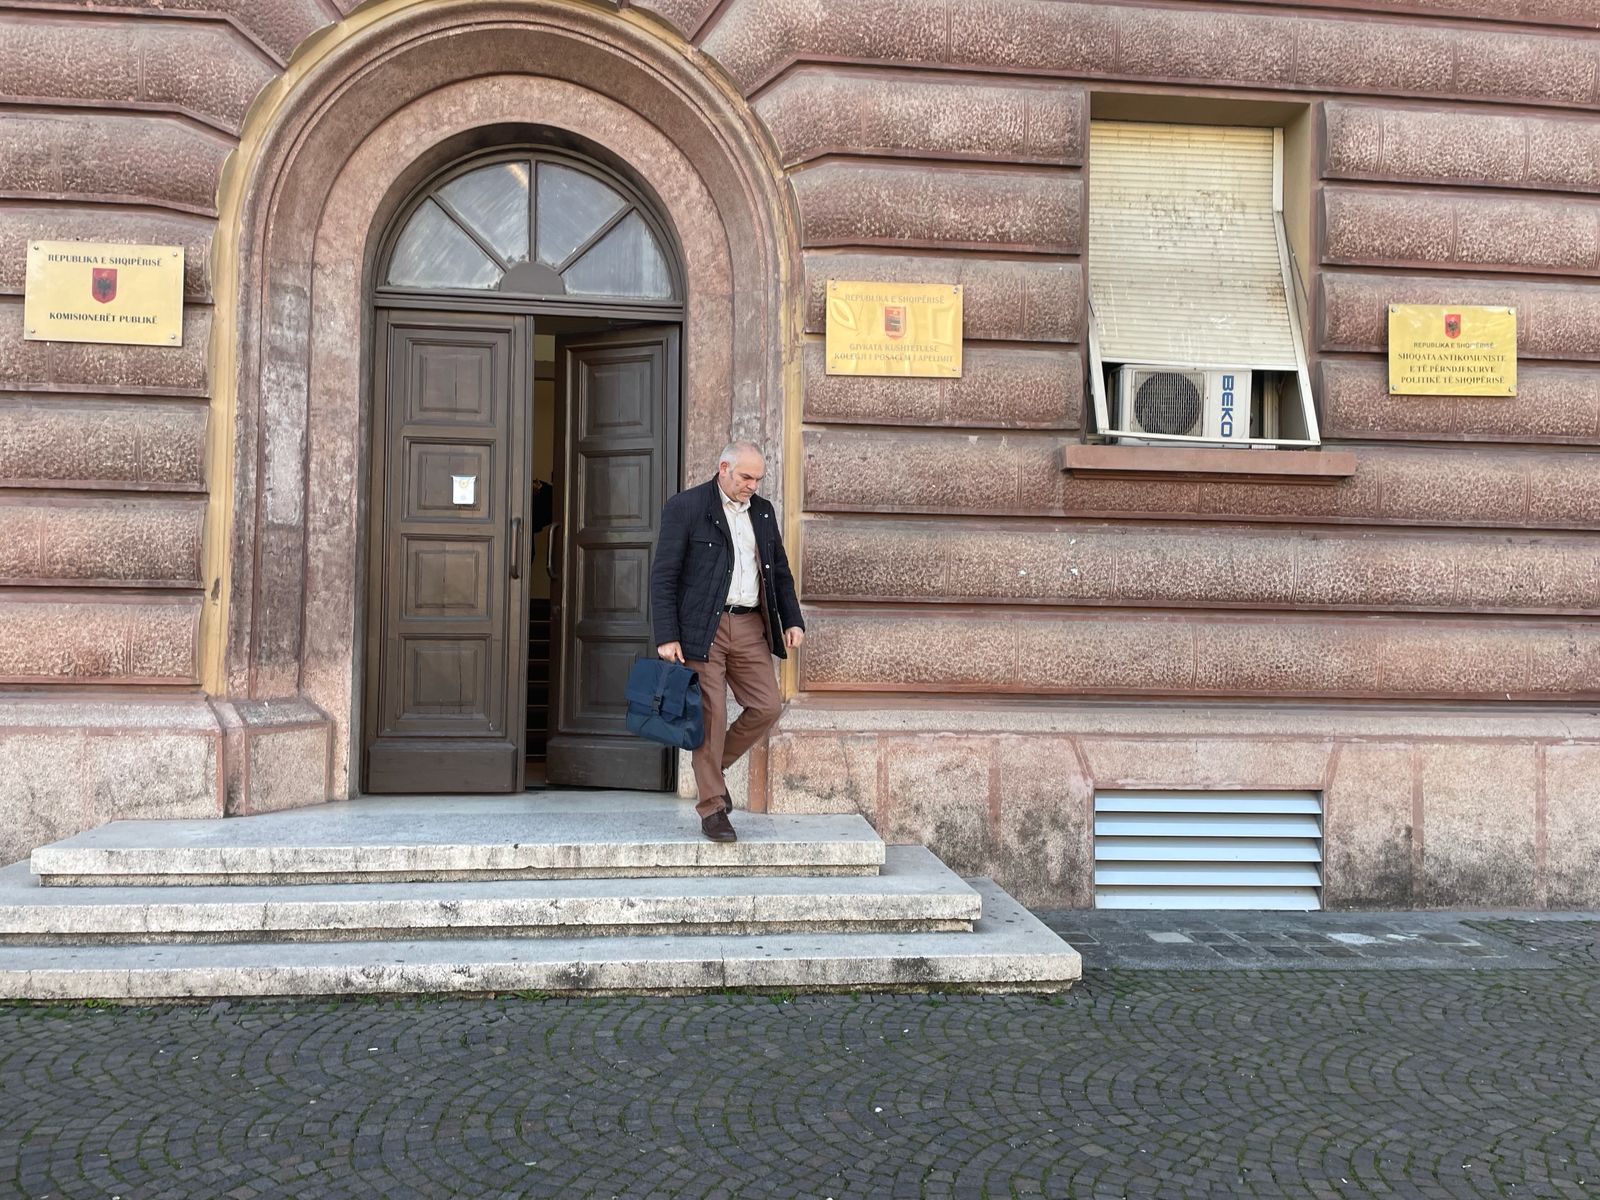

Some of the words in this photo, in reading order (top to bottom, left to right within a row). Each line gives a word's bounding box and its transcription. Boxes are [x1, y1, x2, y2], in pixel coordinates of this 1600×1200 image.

[48, 254, 98, 264] REPUBLIKA
[101, 257, 107, 265] E
[109, 257, 162, 267] SHQIPËRISË
[845, 294, 889, 303] REPUBLIKA
[890, 296, 897, 304] E
[898, 295, 944, 305] SHQIPËRISË
[49, 312, 116, 323] KOMISIONERËT
[119, 316, 158, 325] PUBLIKË
[1398, 353, 1436, 361] SHOQATA
[1436, 354, 1505, 362] ANTIKOMUNISTE
[1416, 364, 1428, 372] TË
[1429, 364, 1496, 373] PËRNDJEKURVE
[1401, 376, 1441, 384] POLITIKË
[1443, 375, 1454, 384] TË
[1455, 376, 1504, 385] SHQIPËRISË
[1220, 375, 1235, 437] BEKO
